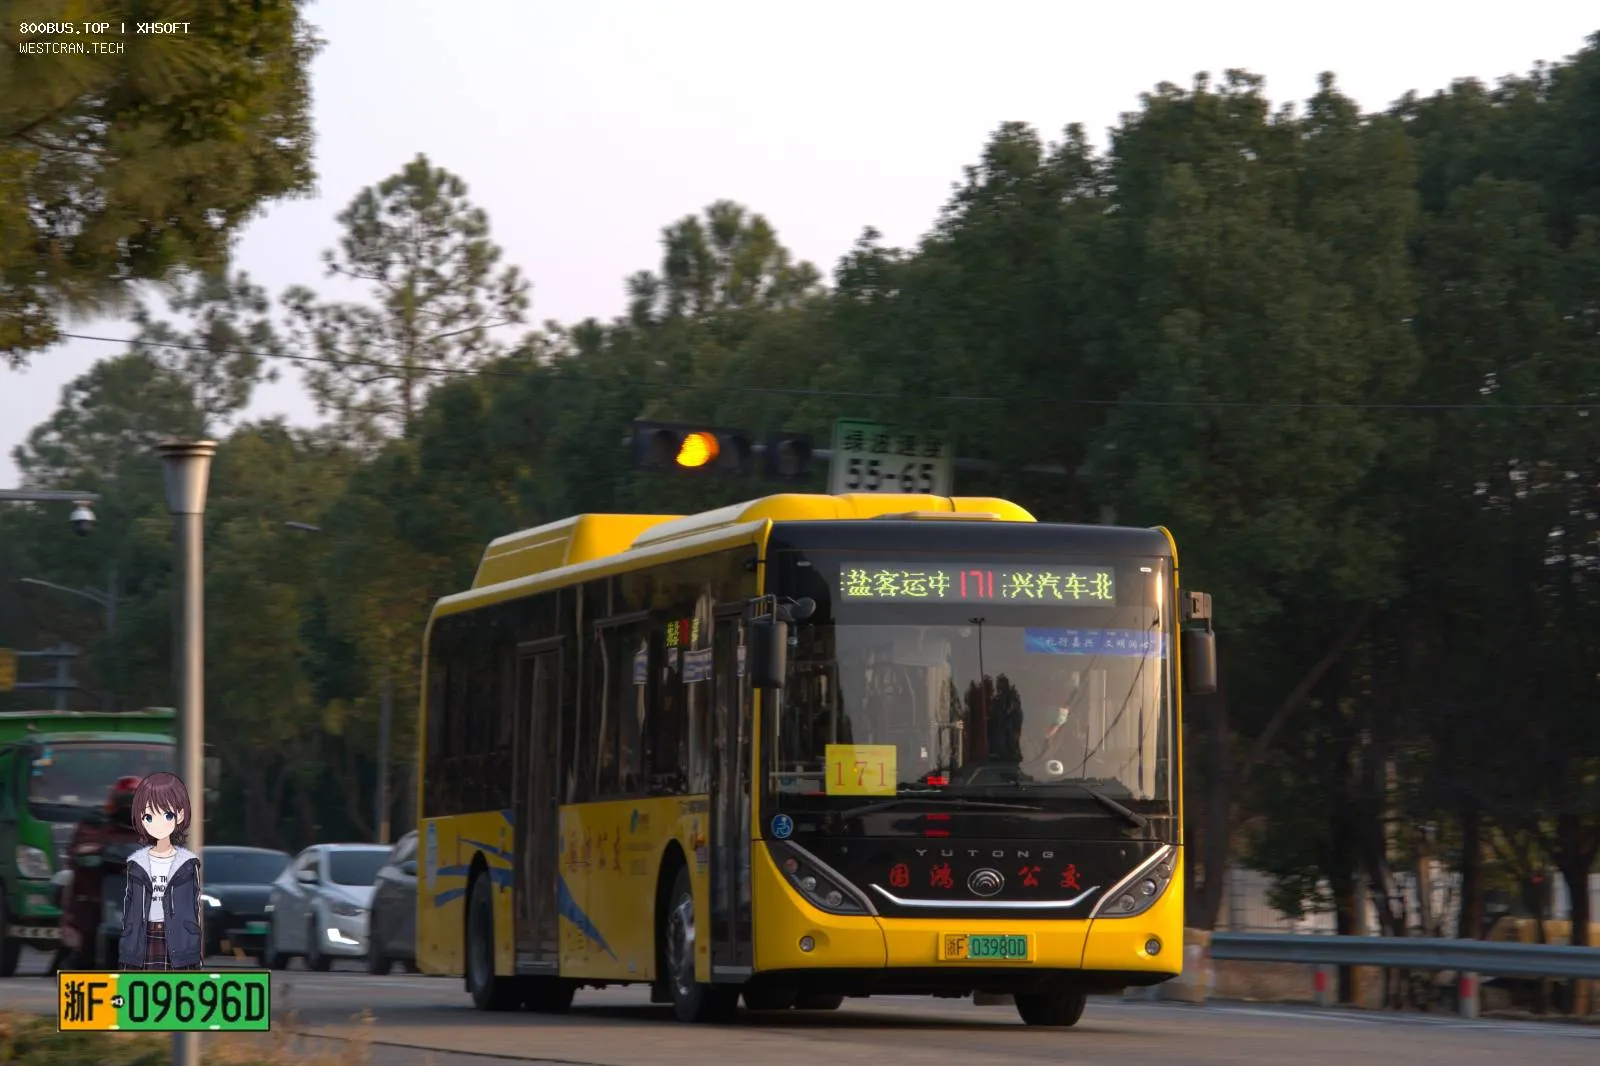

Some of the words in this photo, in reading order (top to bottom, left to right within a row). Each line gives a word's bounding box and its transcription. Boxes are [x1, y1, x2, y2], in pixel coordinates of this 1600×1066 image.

[846, 458, 936, 493] 55-65
[840, 569, 950, 598] 盐客运中
[960, 570, 994, 599] 171
[1002, 571, 1113, 600] 兴汽车北
[835, 761, 888, 787] 171
[915, 849, 1054, 858] YUTONG
